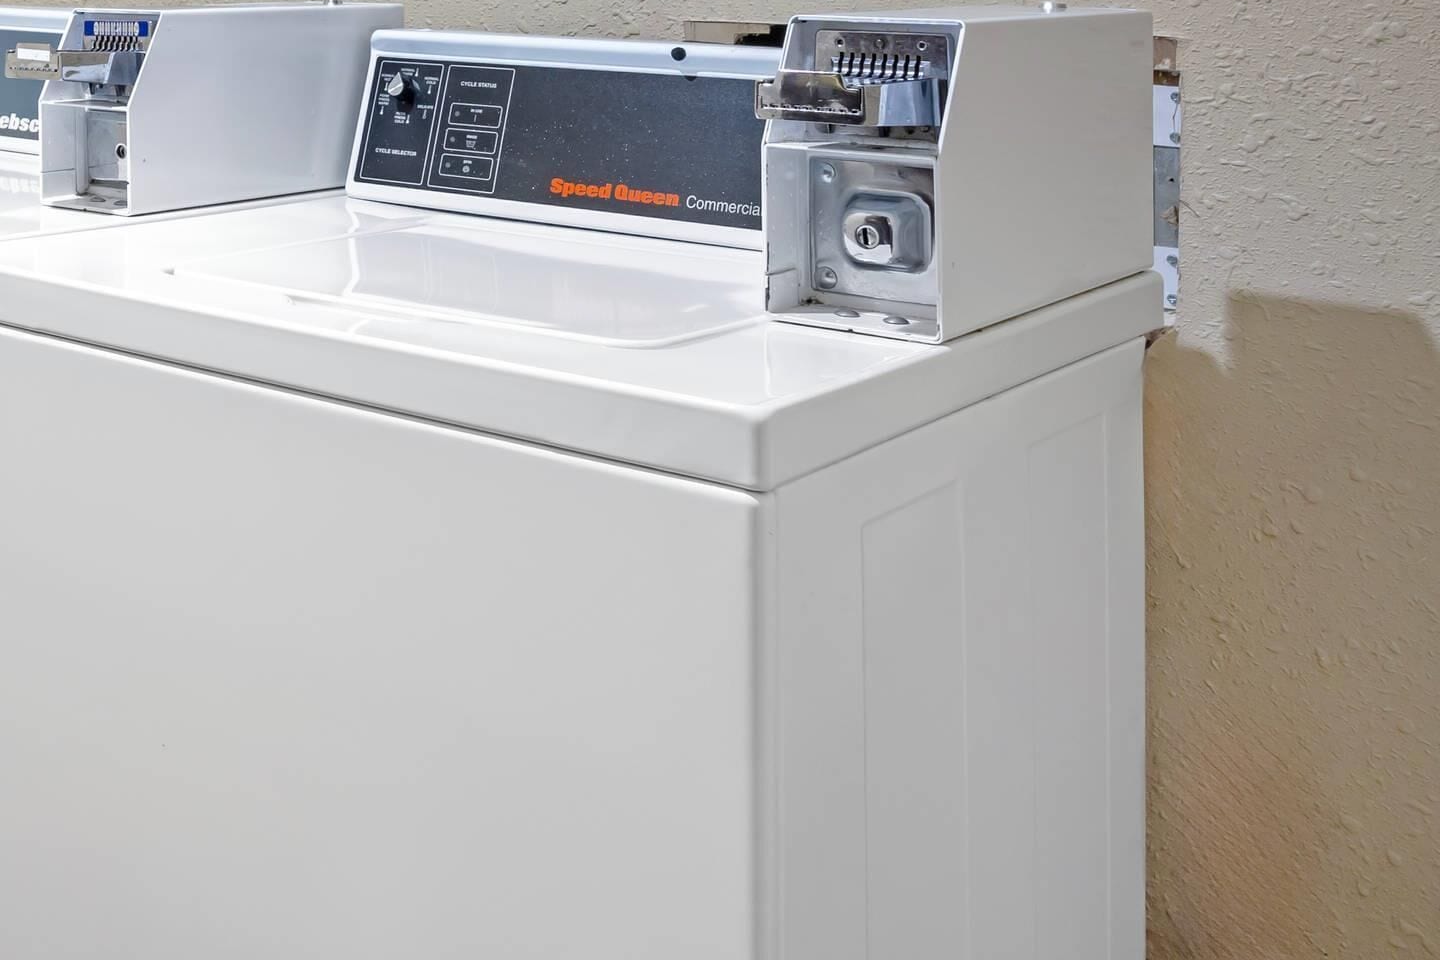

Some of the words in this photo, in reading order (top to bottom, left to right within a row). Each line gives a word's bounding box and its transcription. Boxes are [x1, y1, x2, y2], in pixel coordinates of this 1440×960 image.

[460, 80, 477, 88] CYCLE
[375, 147, 391, 155] CYCLE
[550, 178, 612, 200] Speed
[614, 184, 681, 207] Queen
[686, 195, 762, 217] Commercia
